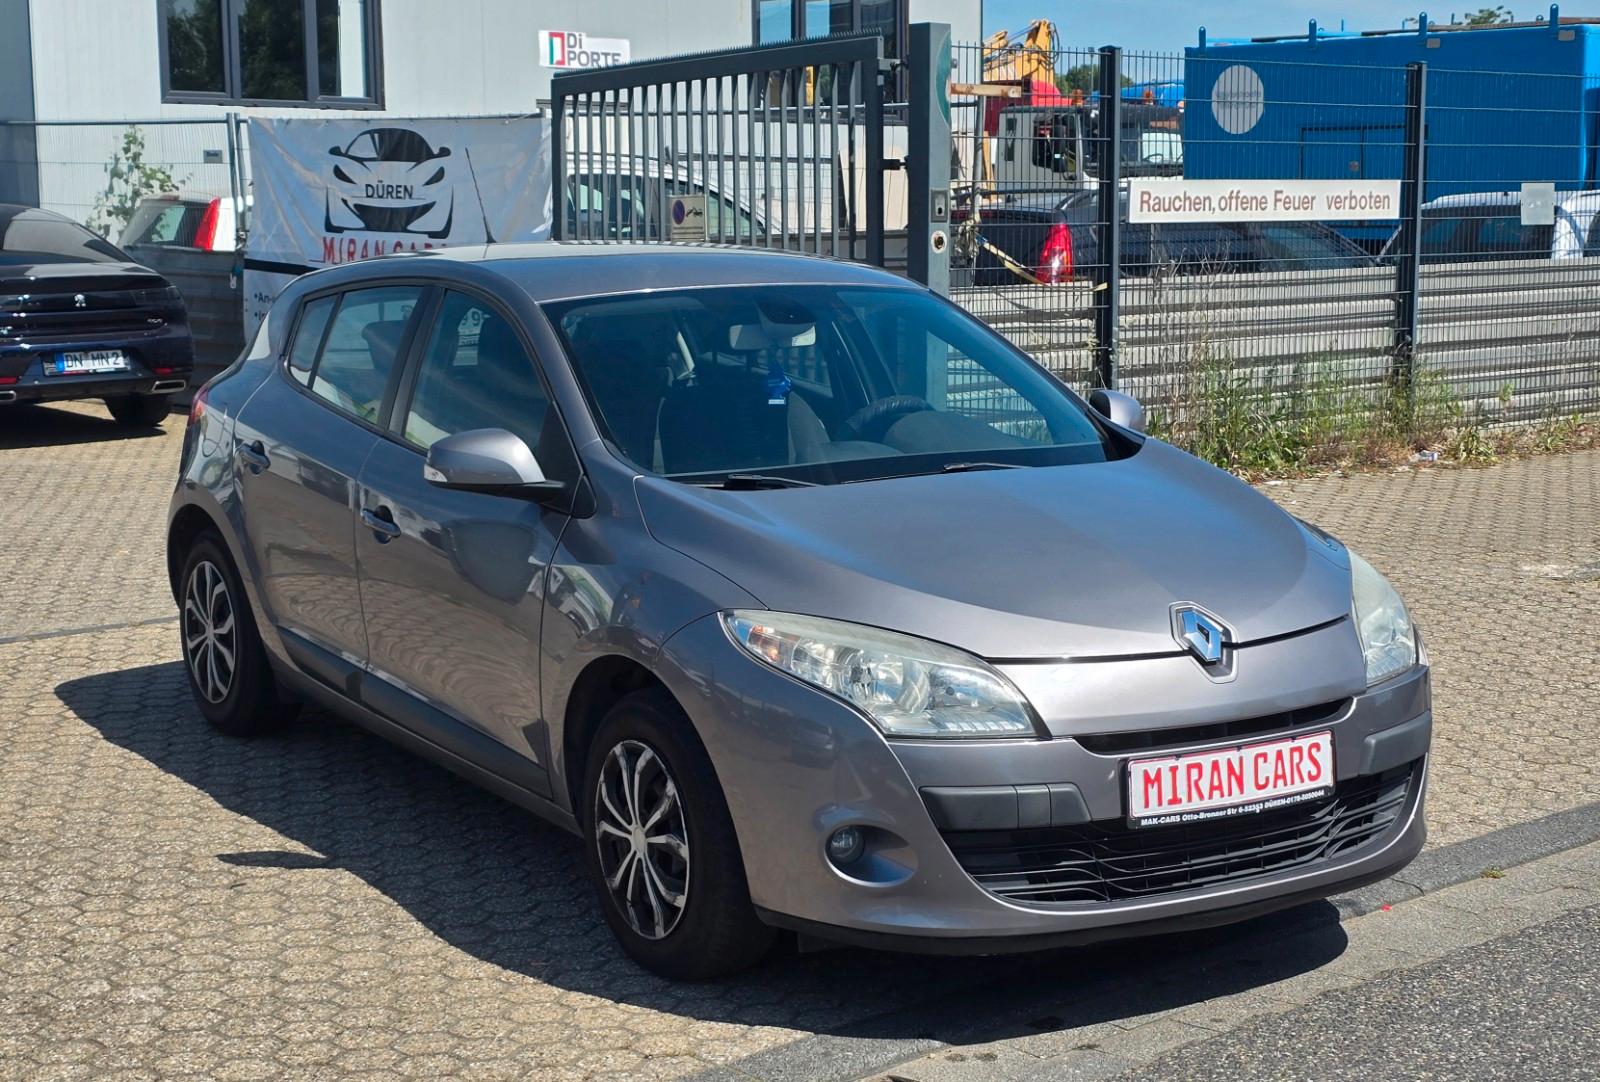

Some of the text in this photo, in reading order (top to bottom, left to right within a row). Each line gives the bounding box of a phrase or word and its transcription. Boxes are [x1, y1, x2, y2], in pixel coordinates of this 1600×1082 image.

[567, 32, 583, 50] Di
[365, 180, 414, 200] DÜREN
[1139, 189, 1391, 215] Rauchen, offene Feuer verboten
[323, 236, 386, 264] MIRAN
[66, 351, 120, 368] DN MN 2
[1143, 742, 1322, 809] MIRAN CARS
[1140, 814, 1181, 826] MAK-CARS
